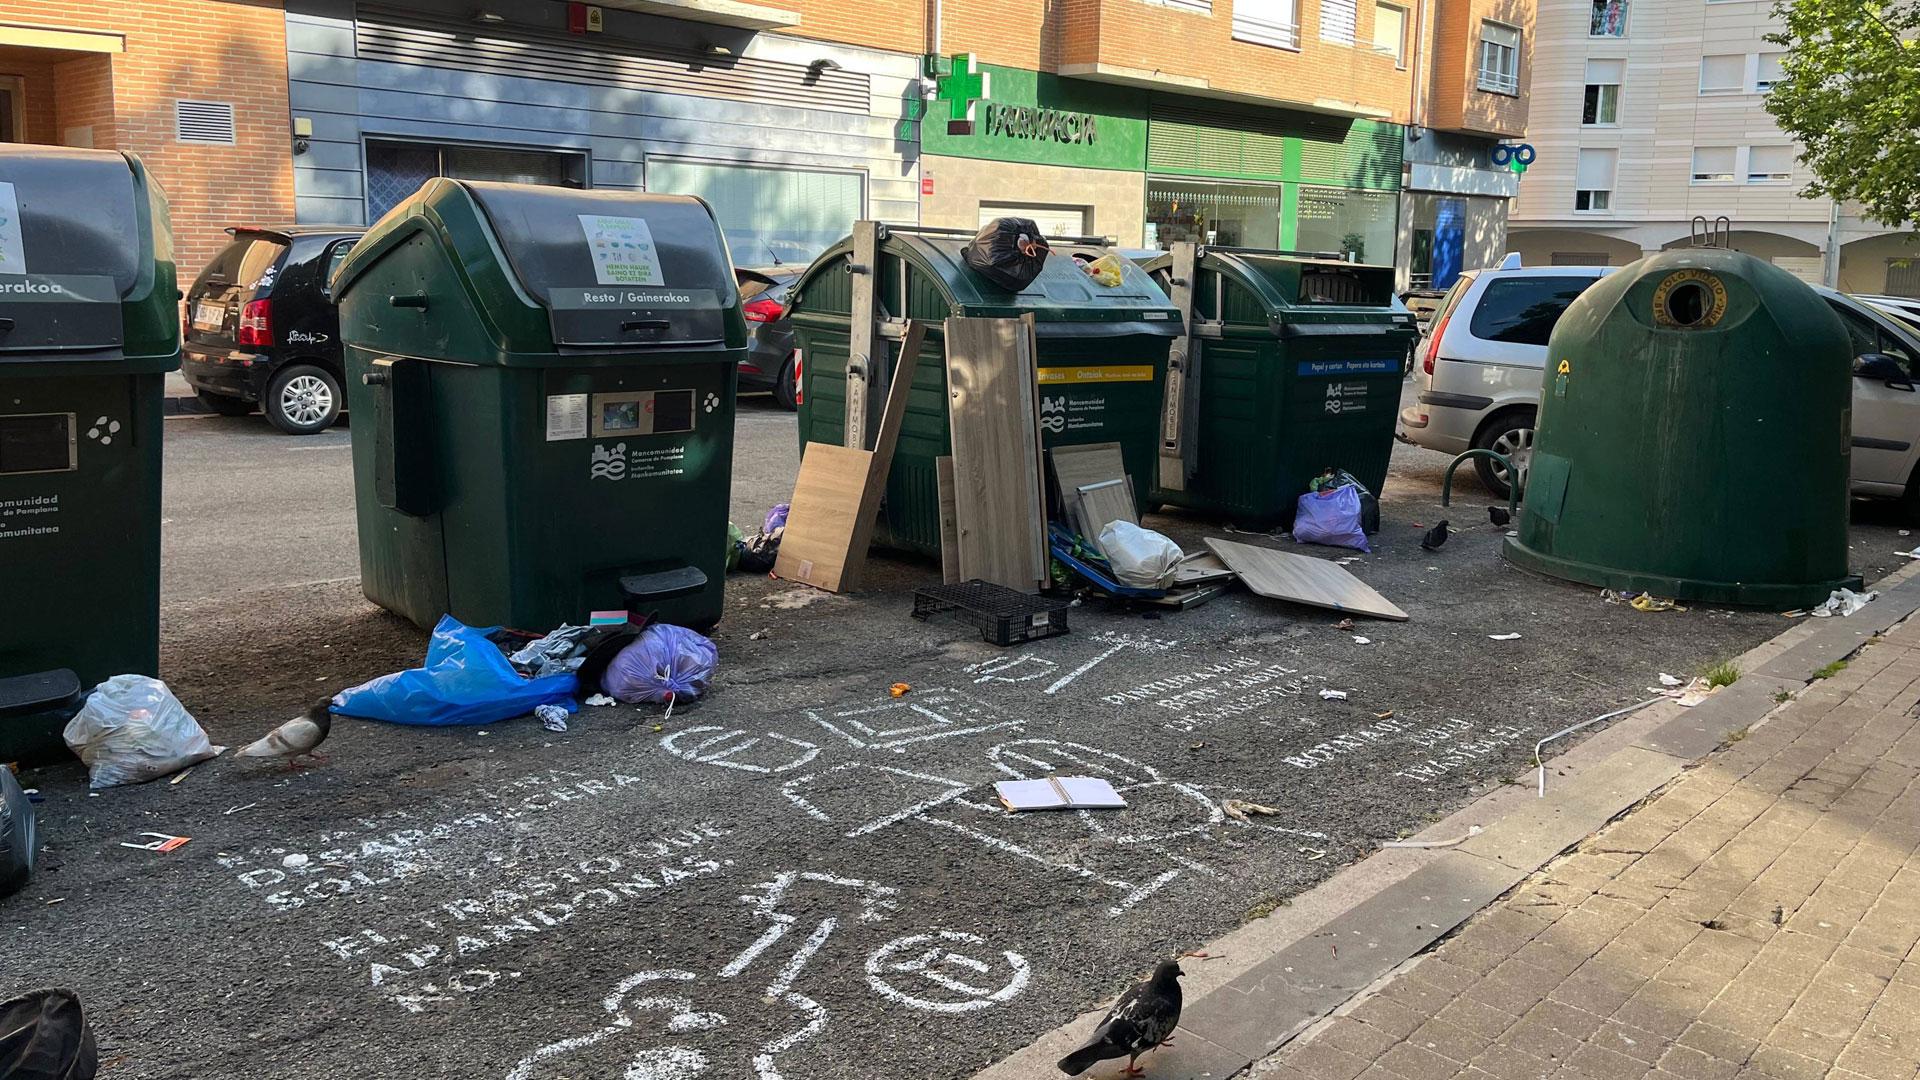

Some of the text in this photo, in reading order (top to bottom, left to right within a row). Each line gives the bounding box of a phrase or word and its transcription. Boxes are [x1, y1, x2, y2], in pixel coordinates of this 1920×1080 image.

[987, 103, 1097, 145] FARMACIA
[583, 292, 615, 303] Resto
[627, 292, 690, 303] Gainerakoa
[631, 446, 685, 457] Mancomunidad
[16, 506, 59, 515] Pamplona
